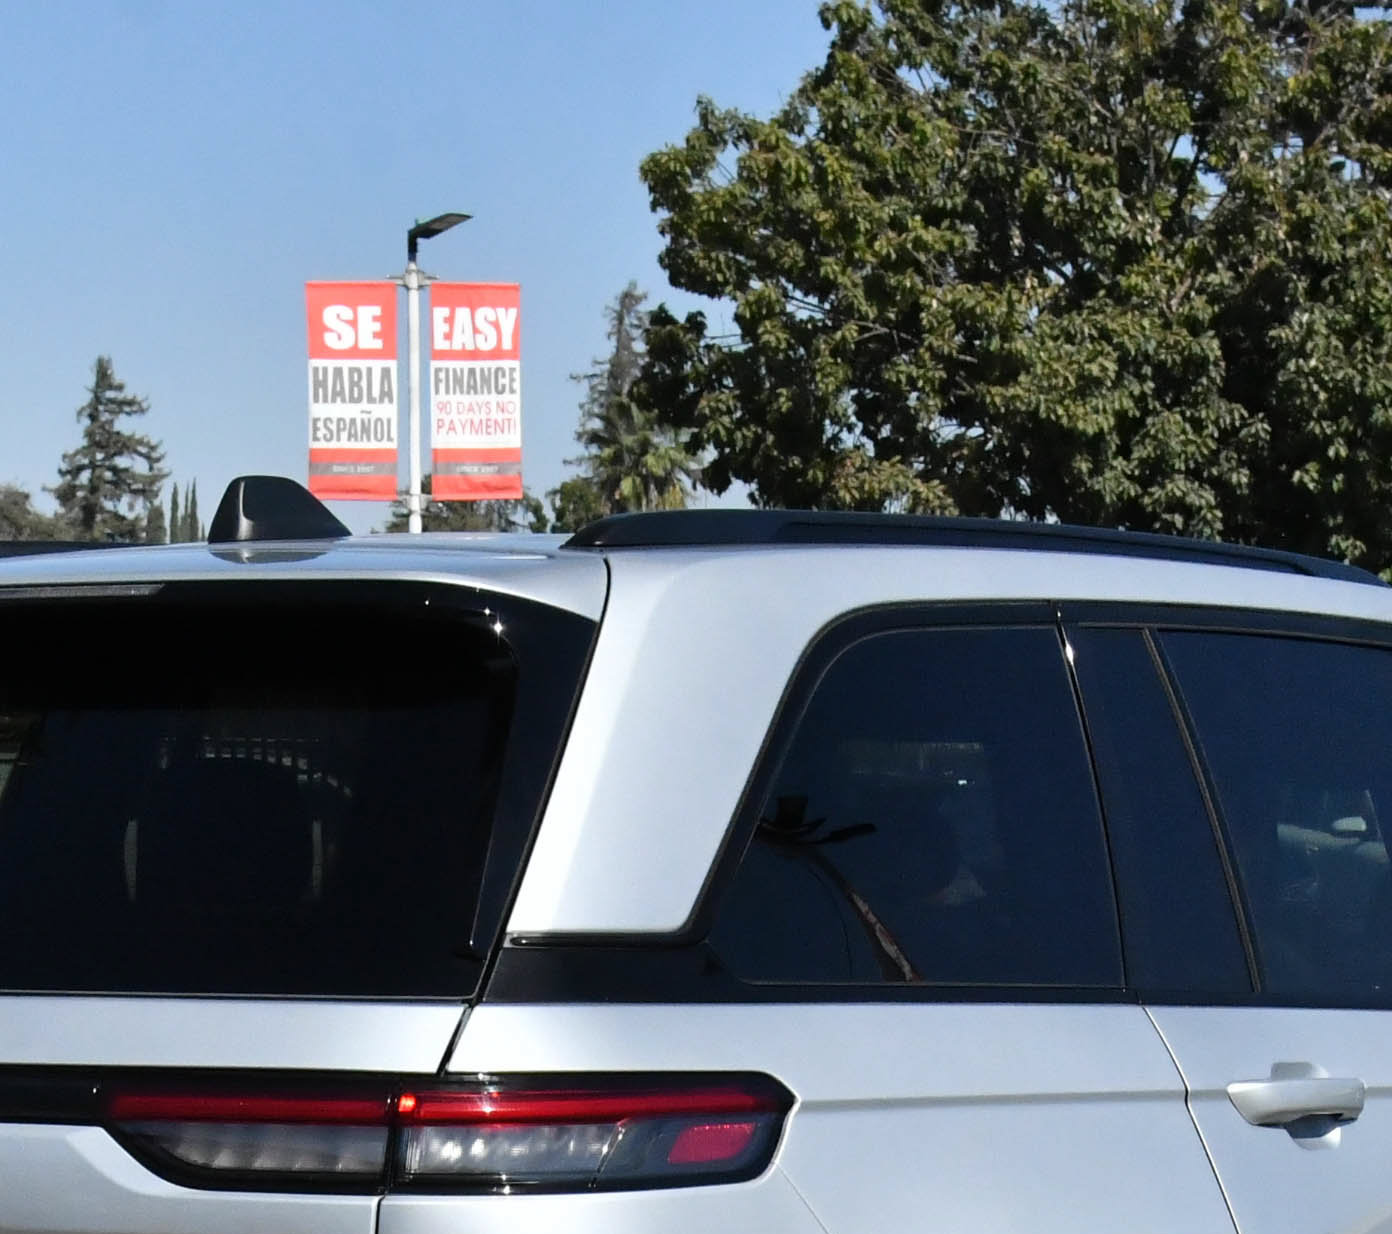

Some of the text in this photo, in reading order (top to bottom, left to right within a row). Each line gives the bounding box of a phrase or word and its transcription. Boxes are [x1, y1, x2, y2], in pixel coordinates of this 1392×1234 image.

[322, 305, 384, 350] SE
[432, 306, 518, 350] EASY
[312, 366, 394, 404] HABLA
[434, 367, 517, 395] FINANCE
[436, 401, 516, 416] 90 DAYS NO
[312, 409, 394, 443] ESPAÑOL
[436, 418, 517, 436] PAYMENT!
